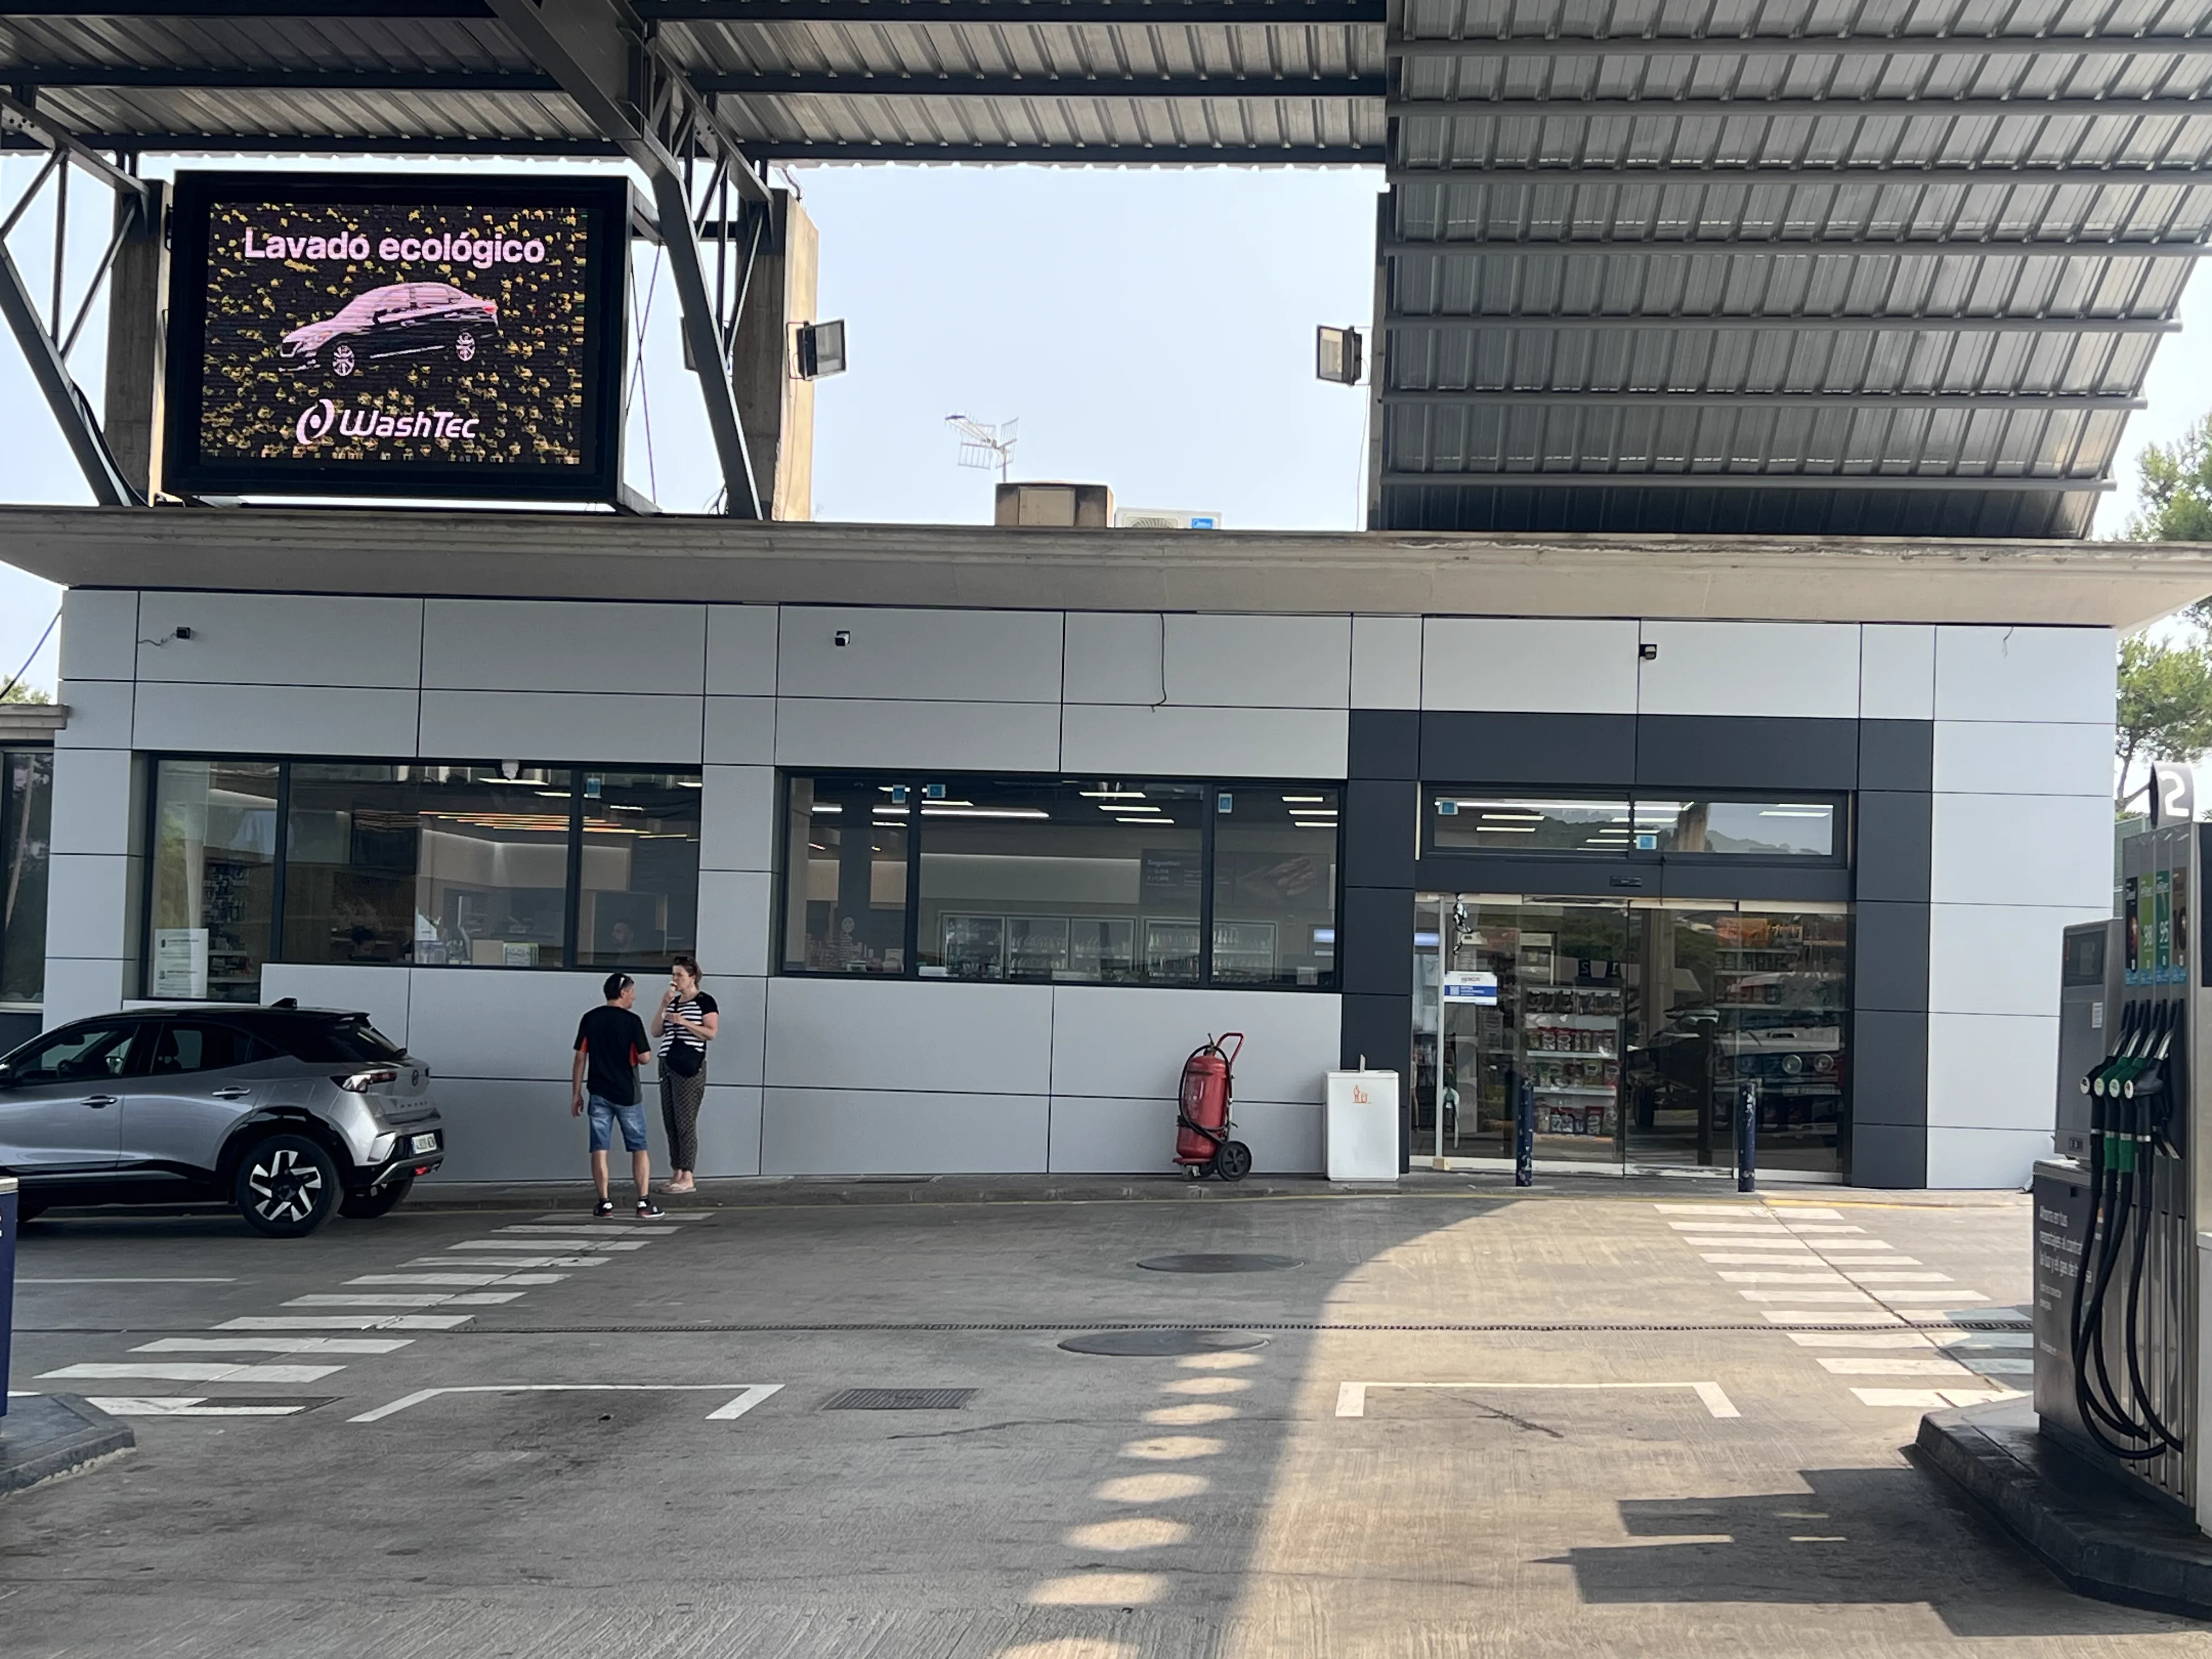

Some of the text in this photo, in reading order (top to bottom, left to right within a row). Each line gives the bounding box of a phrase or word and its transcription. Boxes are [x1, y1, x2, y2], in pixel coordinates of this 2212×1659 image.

[244, 228, 545, 269] Lavado ecológico
[340, 410, 481, 439] WashTec
[2158, 771, 2189, 817] 2
